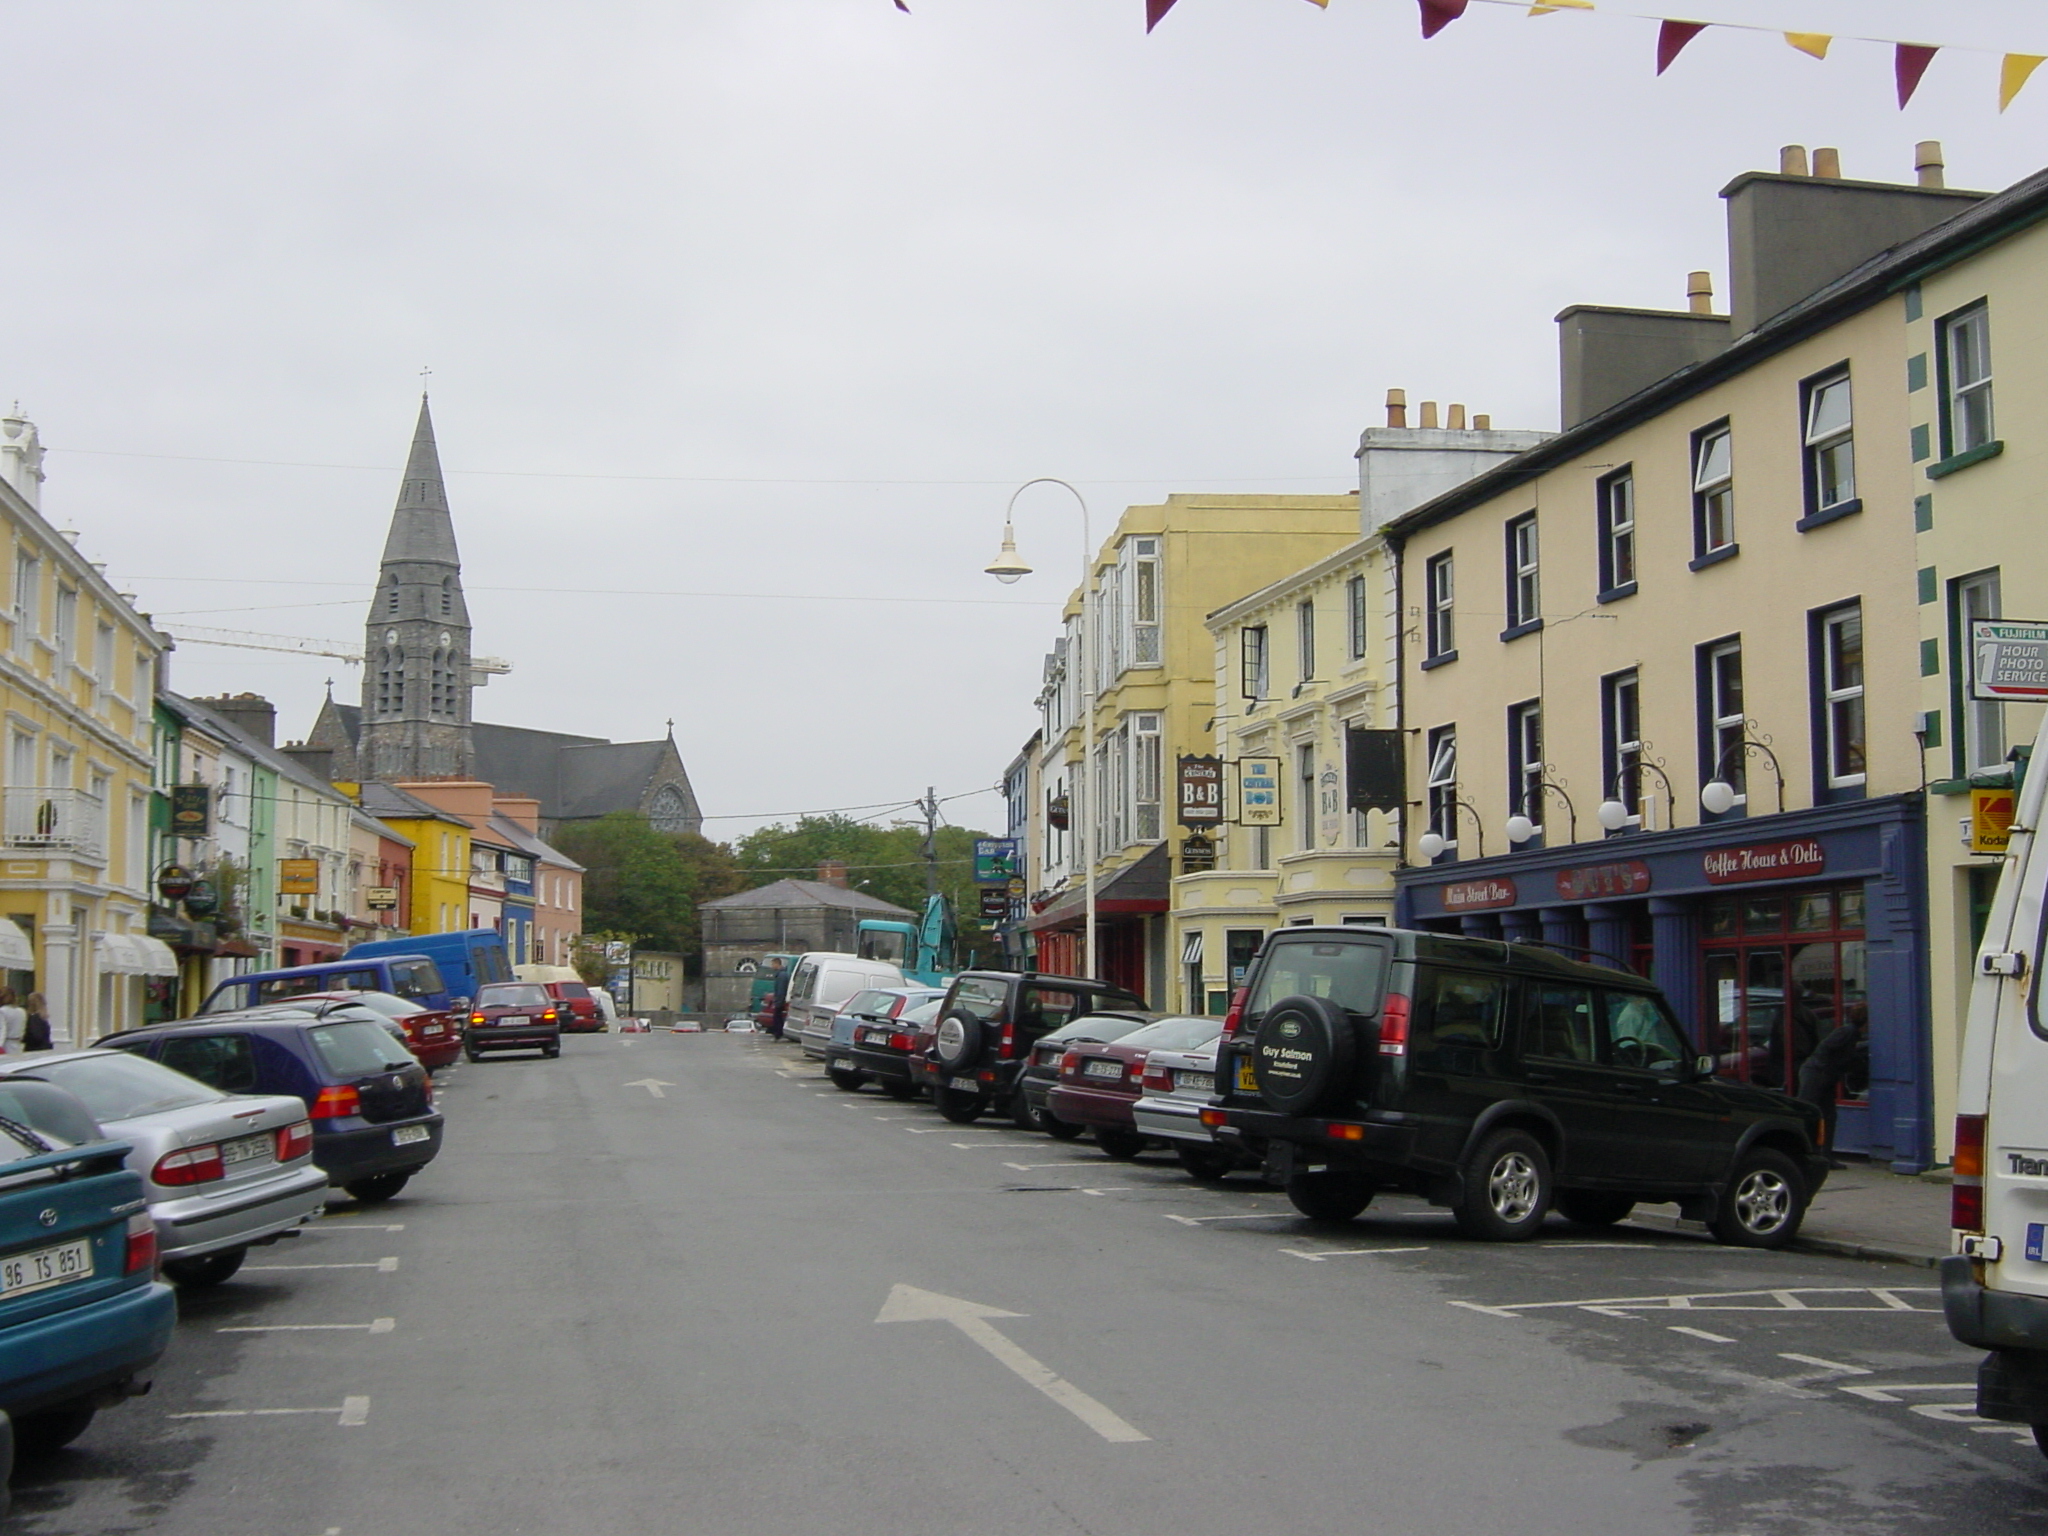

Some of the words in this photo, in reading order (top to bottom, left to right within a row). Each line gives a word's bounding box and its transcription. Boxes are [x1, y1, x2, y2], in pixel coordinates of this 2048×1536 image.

[2000, 628, 2046, 639] FUJIFILM
[1978, 643, 1998, 684] 1
[2002, 645, 2039, 657] HOUR
[2000, 657, 2044, 670] PHOTO
[1997, 670, 2047, 682] SERVICE
[1704, 853, 1738, 877] Coffee
[1739, 849, 1777, 870] House
[1780, 848, 1789, 866] &
[1445, 887, 1465, 906] Main
[1466, 885, 1489, 902] Street
[1489, 882, 1511, 900] Bar
[1263, 1046, 1280, 1059] Guy
[1280, 1047, 1313, 1062] Salmon
[2027, 1246, 2042, 1256] IRL
[5, 1262, 23, 1287] 96
[34, 1255, 52, 1280] TS
[58, 1247, 82, 1274] 851
